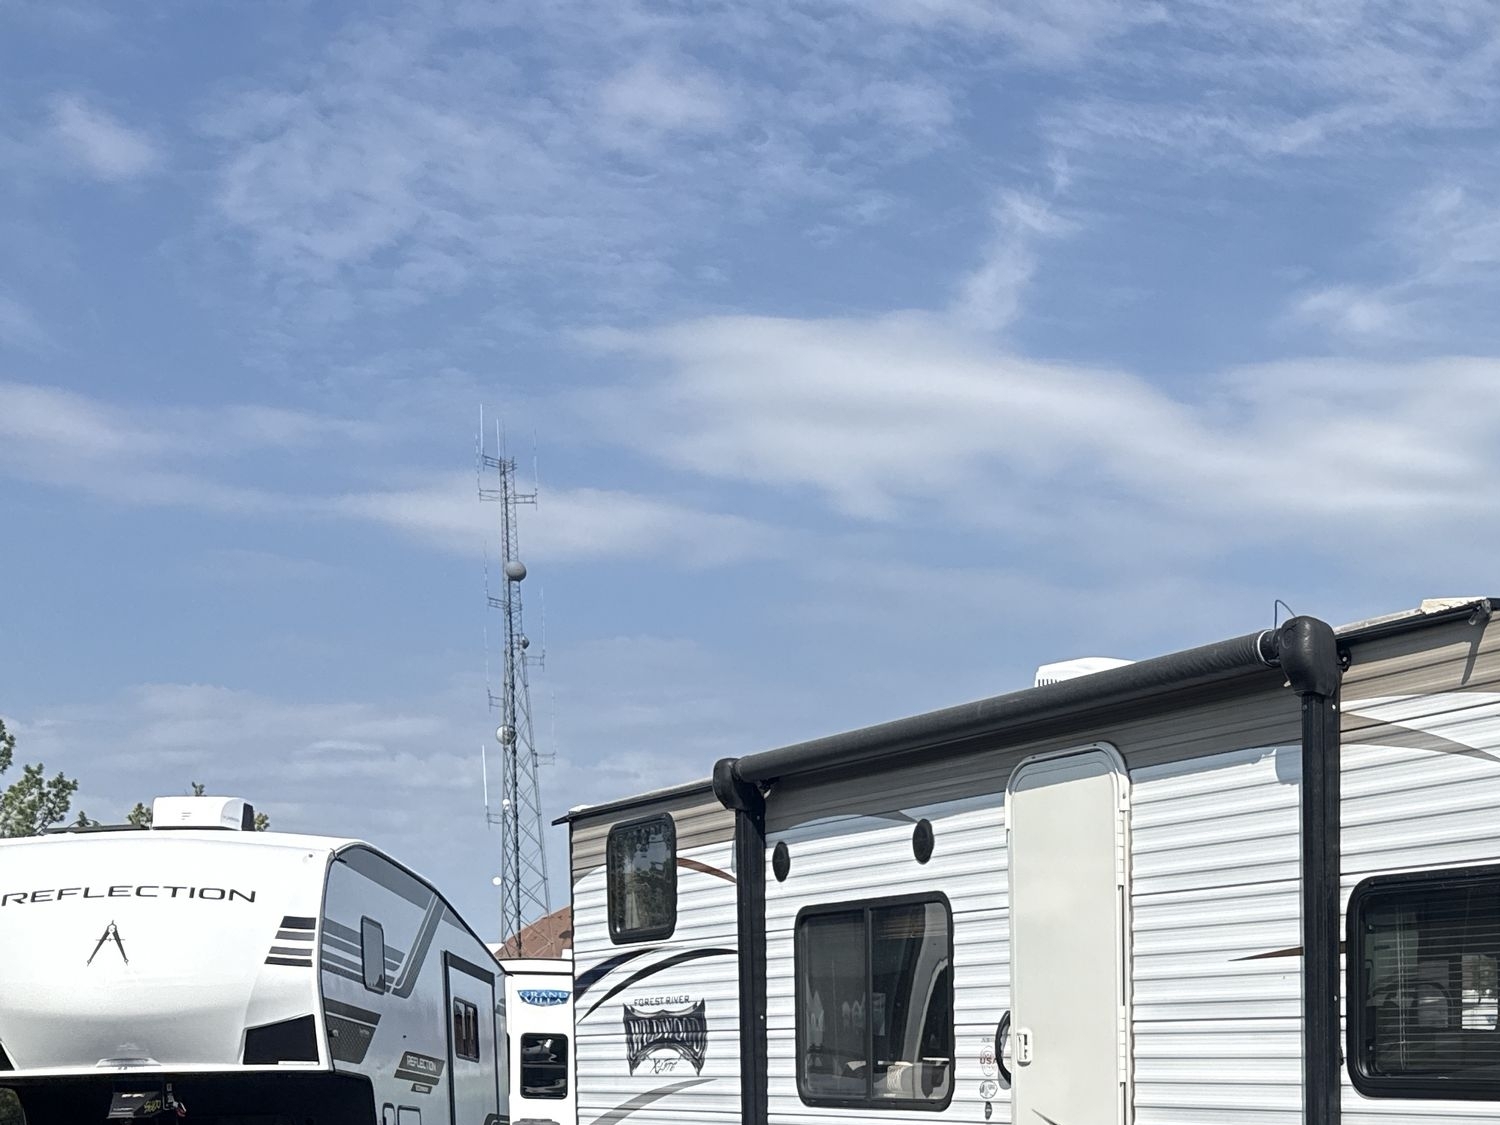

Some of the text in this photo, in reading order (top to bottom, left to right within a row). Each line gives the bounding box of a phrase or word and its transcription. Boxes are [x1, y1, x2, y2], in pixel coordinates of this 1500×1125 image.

[1, 884, 257, 907] REFLECTION
[523, 996, 563, 1004] VILLA
[633, 994, 690, 1007] FOREST RIVER
[627, 1016, 703, 1059] WILDWOOD
